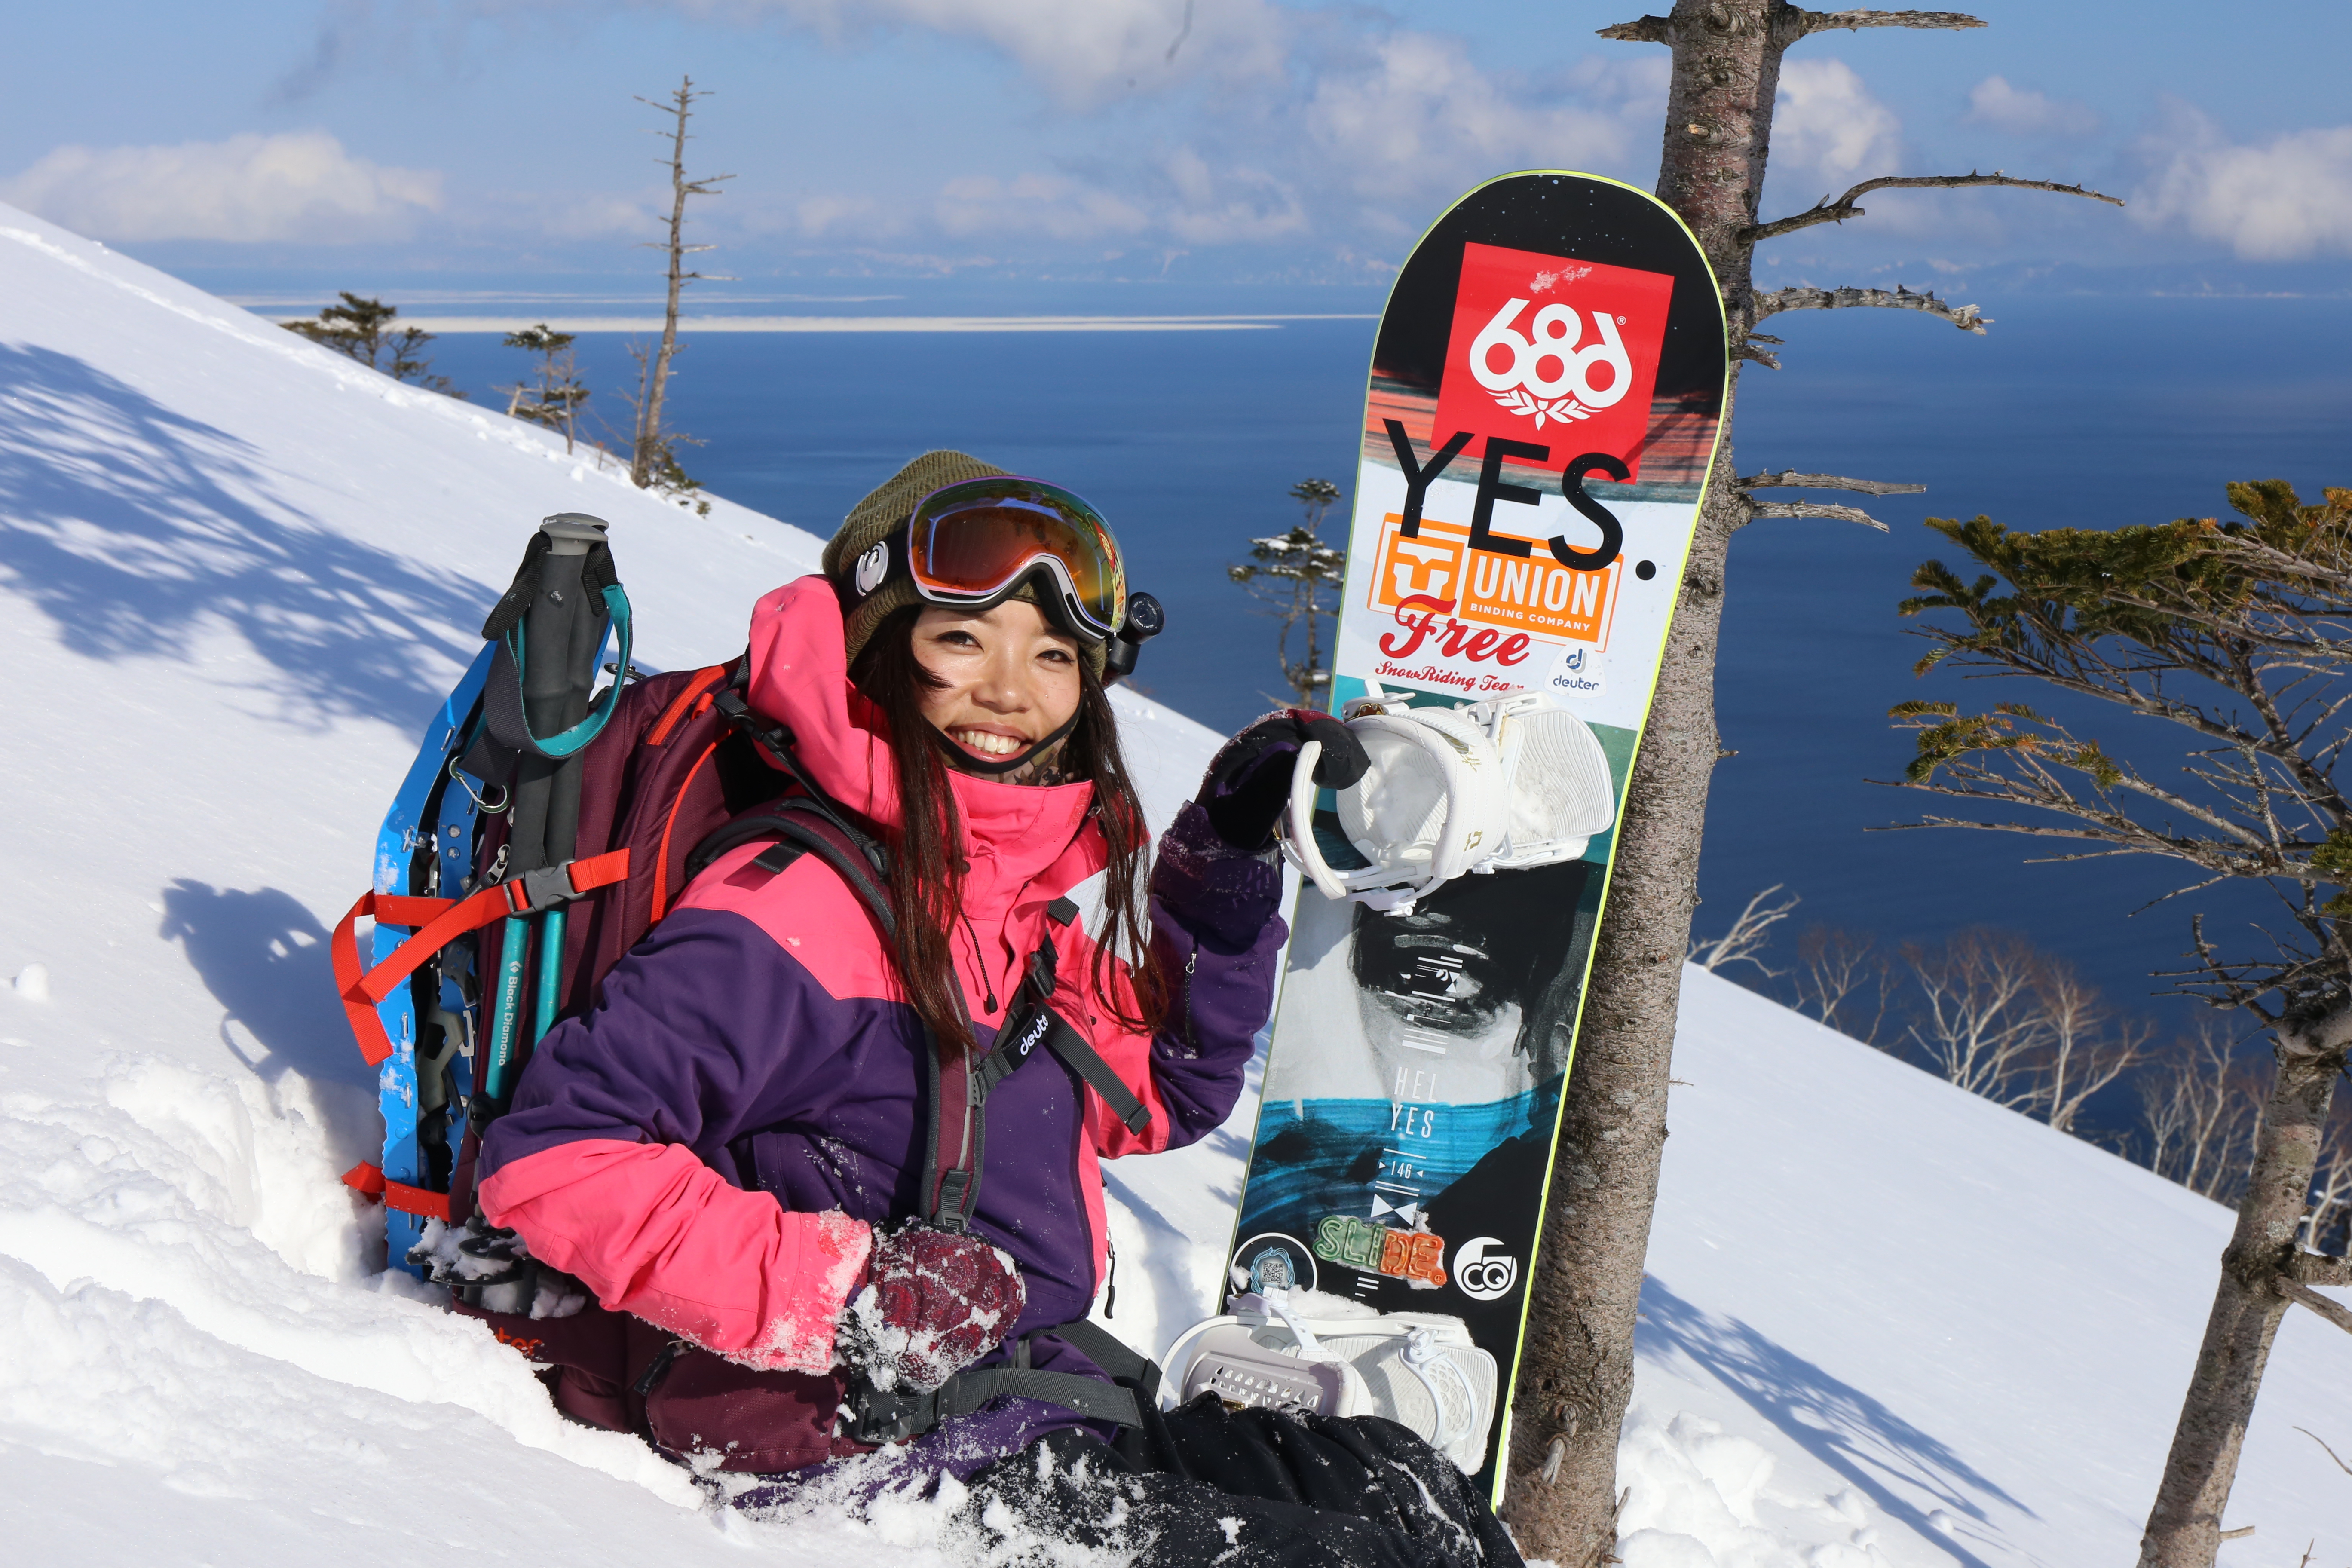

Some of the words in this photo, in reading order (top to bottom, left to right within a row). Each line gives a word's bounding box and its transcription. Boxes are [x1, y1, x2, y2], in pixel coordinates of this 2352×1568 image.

[1469, 297, 1632, 408] 686
[1382, 418, 1656, 581] YES.
[1473, 556, 1600, 618] UNION
[1379, 594, 1530, 666] Free
[1470, 603, 1524, 620] BINDING
[1528, 614, 1590, 632] COMPANY
[1375, 661, 1476, 691] SnowRiding
[1479, 675, 1524, 691] Tea
[1553, 675, 1599, 691] deuter
[505, 976, 518, 1010] Black
[1020, 1014, 1048, 1056] deute
[1394, 1066, 1437, 1103] HEL
[1390, 1104, 1434, 1139] YES
[1390, 1160, 1412, 1179] 146
[1317, 1219, 1438, 1278] SLIDE
